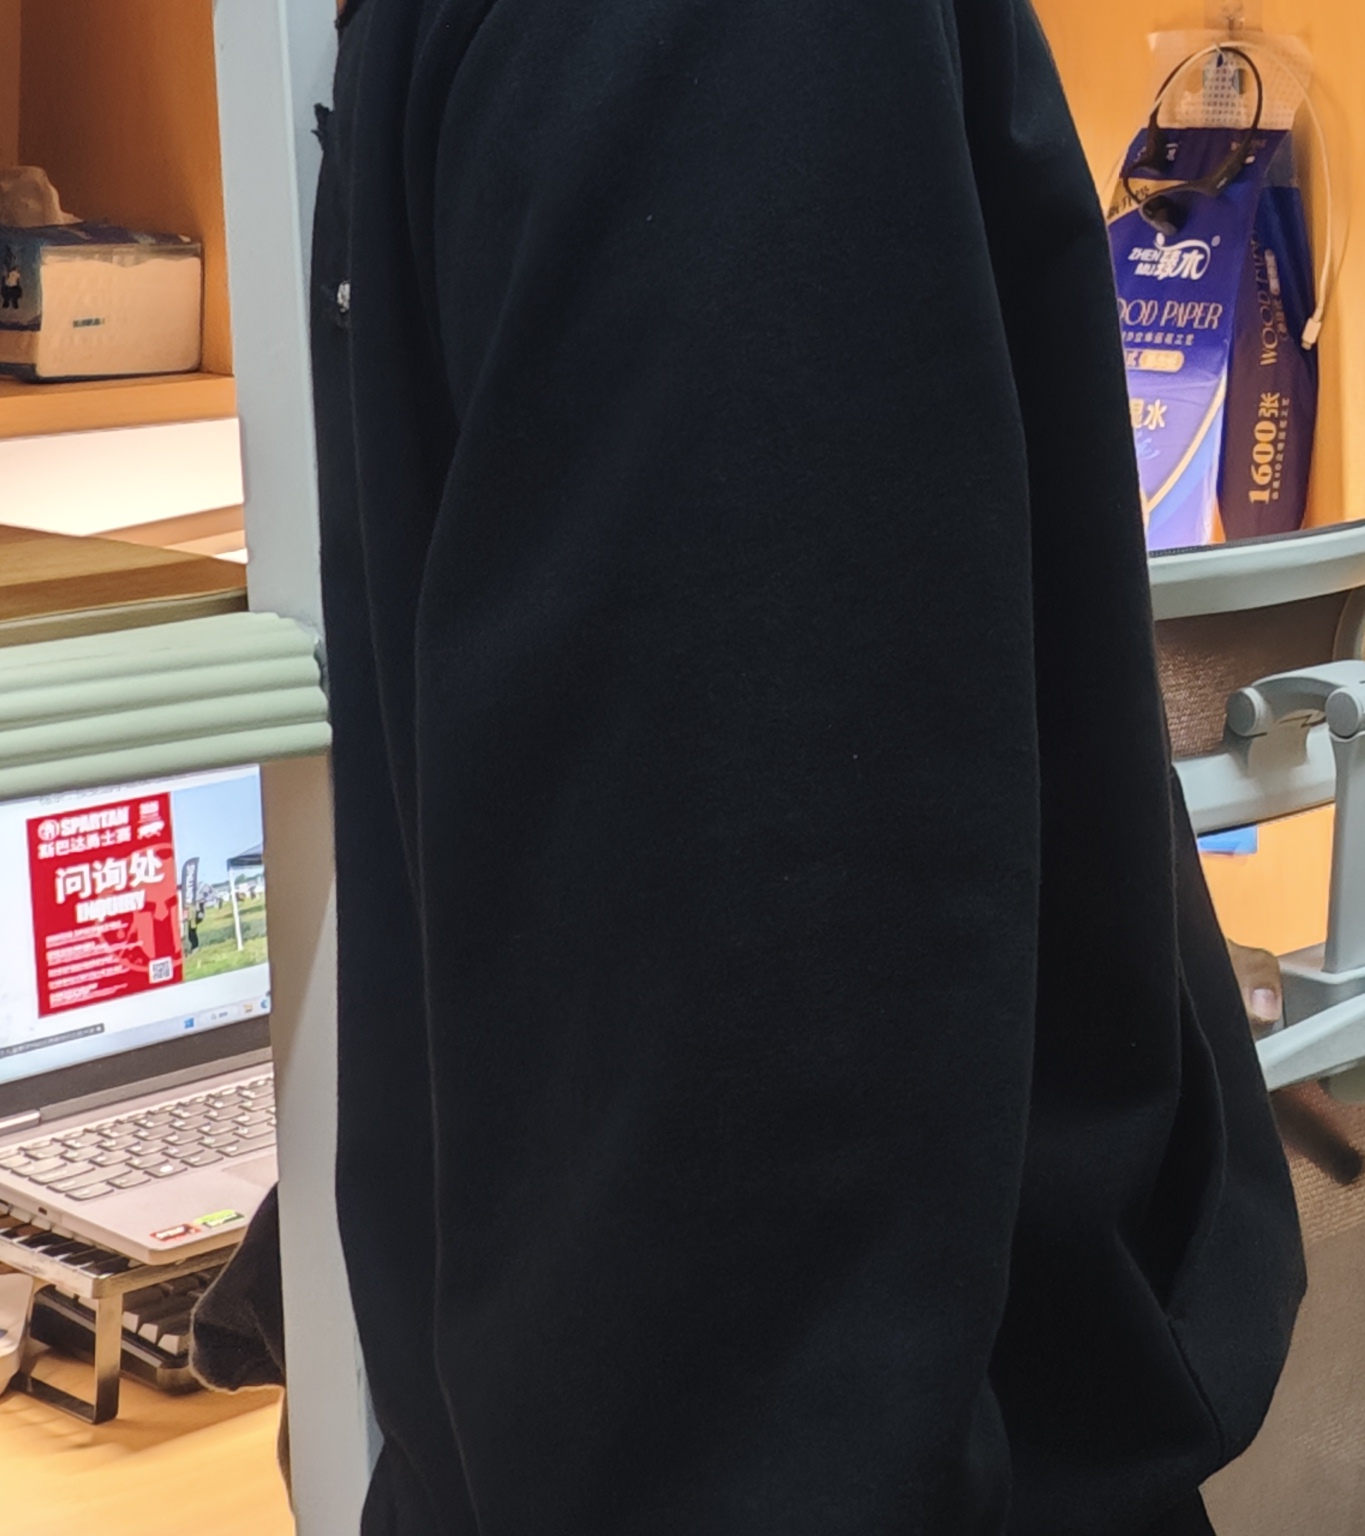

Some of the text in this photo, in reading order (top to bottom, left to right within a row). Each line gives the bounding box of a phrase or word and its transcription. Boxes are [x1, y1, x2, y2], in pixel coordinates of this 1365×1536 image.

[1160, 300, 1223, 330] PAPER
[1249, 392, 1281, 505] 1600张
[55, 848, 165, 905] 问询处
